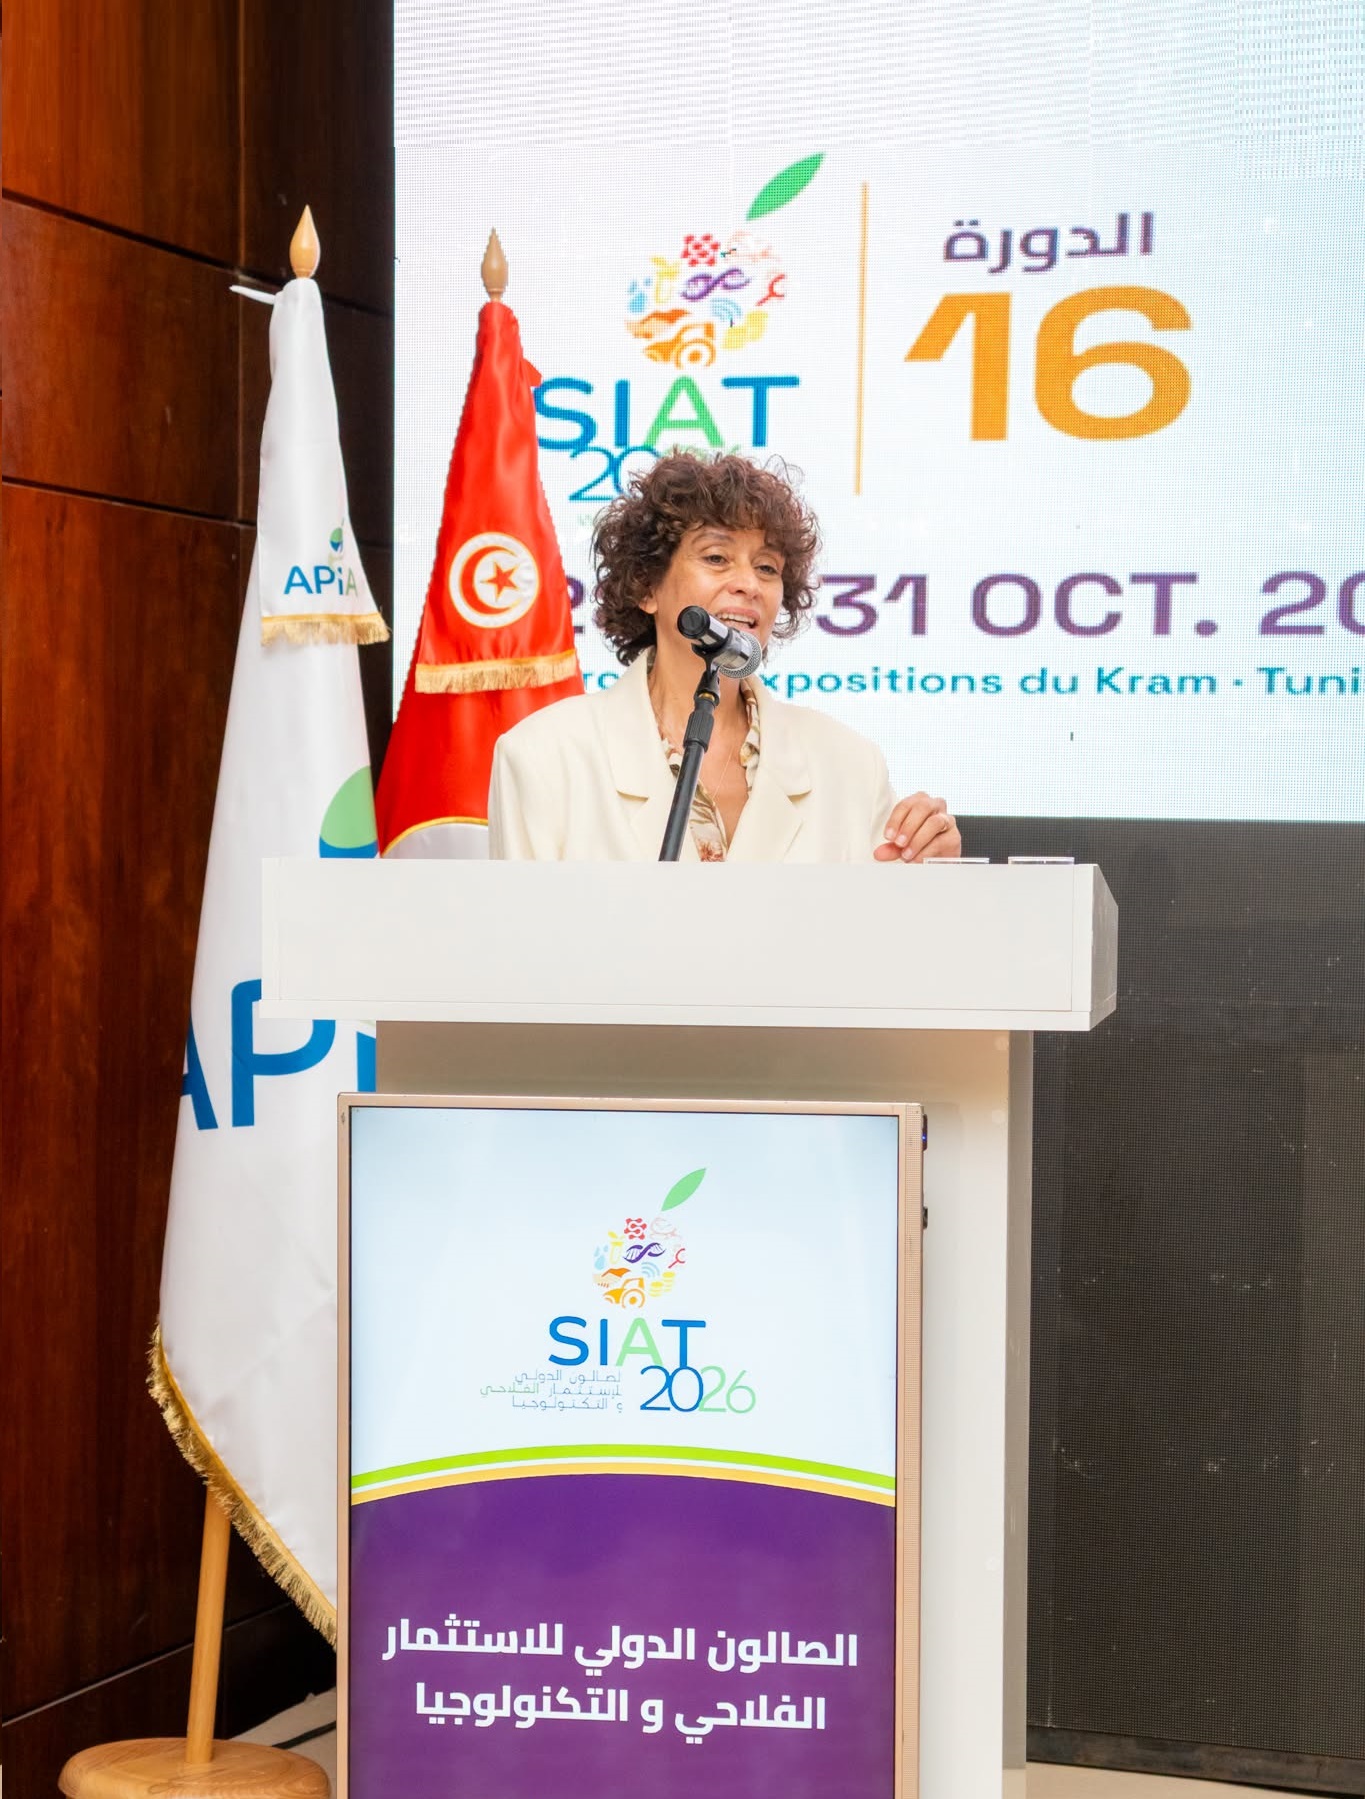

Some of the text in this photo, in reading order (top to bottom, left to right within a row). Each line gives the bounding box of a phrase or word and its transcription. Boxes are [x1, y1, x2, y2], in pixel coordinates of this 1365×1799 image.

[943, 211, 1154, 274] الدورة
[904, 285, 1192, 442] 16
[533, 375, 800, 450] SIAT
[816, 573, 928, 637] 31
[972, 572, 1218, 637] OCT.
[759, 666, 1003, 699] xpositions
[1018, 666, 1079, 695] du
[1096, 666, 1218, 695] Kram
[1256, 666, 1361, 696] Tuni
[548, 1315, 707, 1367] SIAT
[640, 1365, 756, 1414] 2026
[382, 1613, 858, 1677] الصالون الدولي للاستثمار
[416, 1682, 826, 1745] الفلاحي و التكنولوجيا
